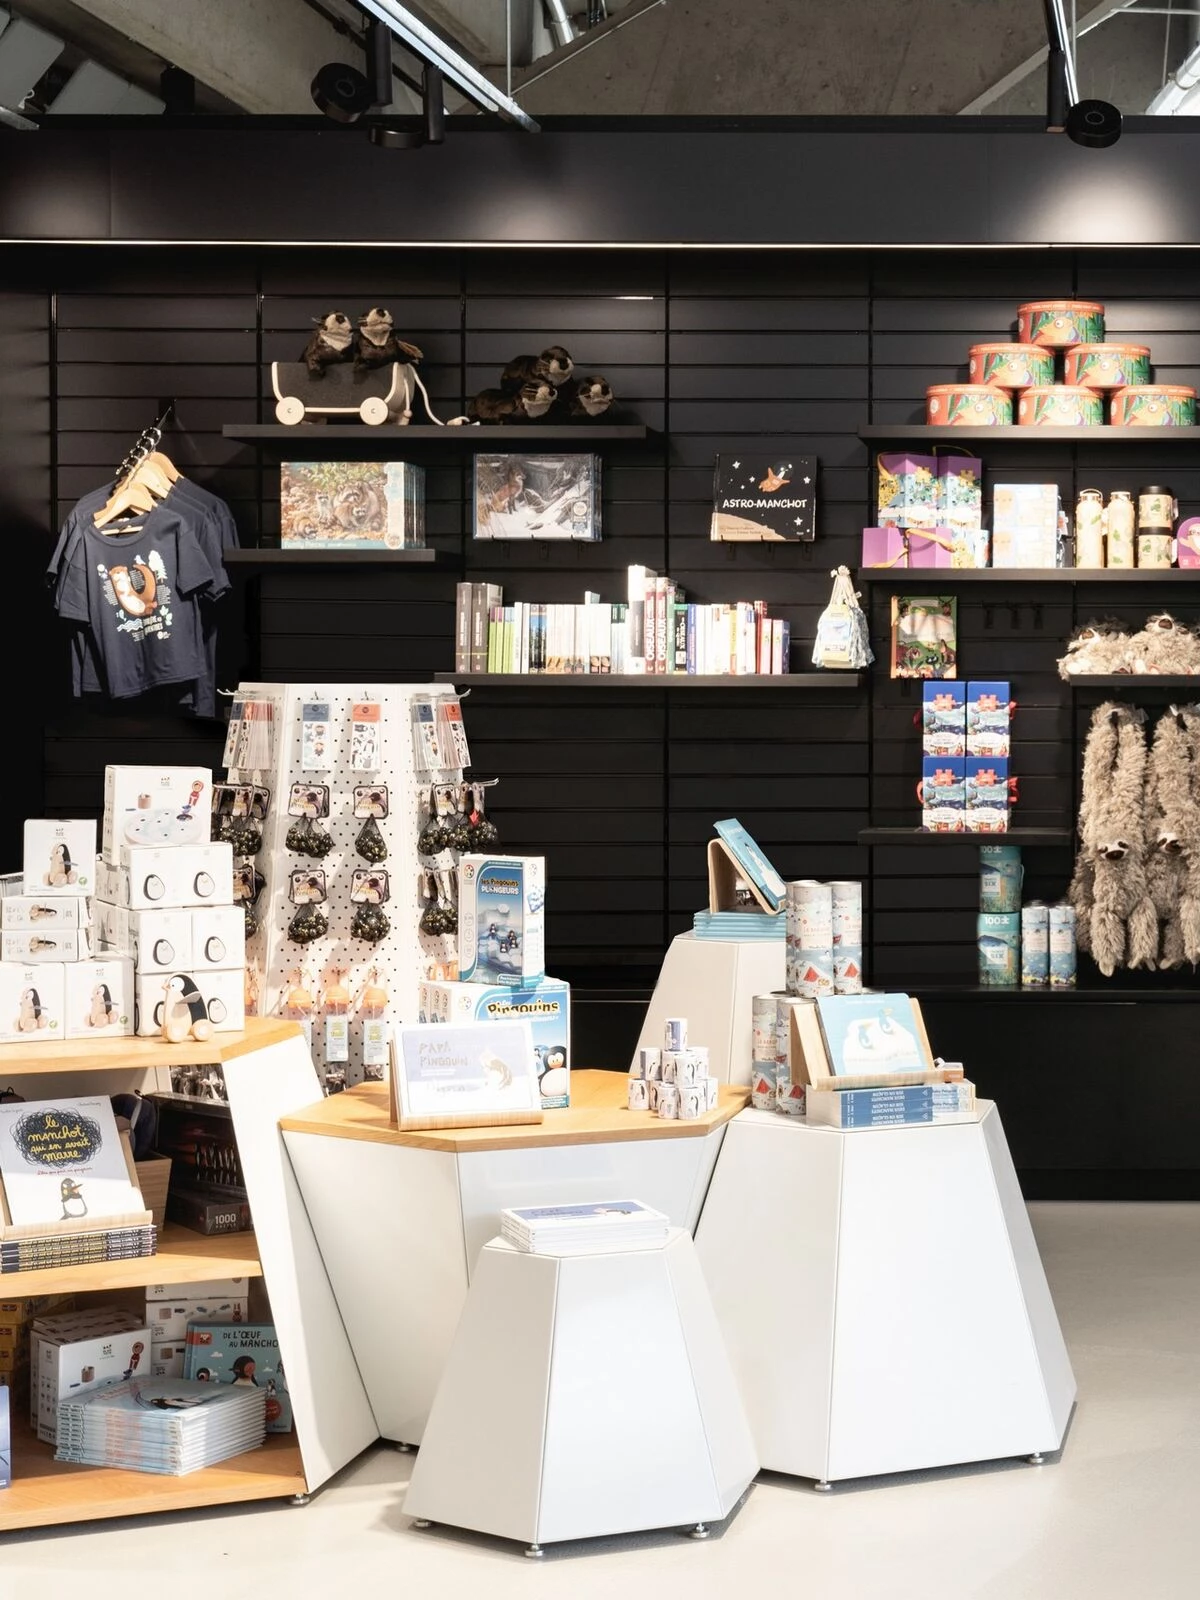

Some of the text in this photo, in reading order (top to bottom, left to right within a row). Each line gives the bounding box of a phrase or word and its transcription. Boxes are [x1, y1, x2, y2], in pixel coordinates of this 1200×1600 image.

[722, 499, 808, 508] ASTRO-MANCHOT
[646, 618, 655, 660] OISEAUX
[658, 618, 667, 660] OISEAUX
[984, 916, 1000, 924] 100
[46, 1115, 59, 1129] le
[28, 1124, 85, 1142] manchot
[30, 1145, 46, 1153] qui
[65, 1137, 91, 1149] avait
[42, 1150, 82, 1162] marre
[215, 1214, 236, 1224] 1000
[240, 1340, 279, 1348] MANCHO
